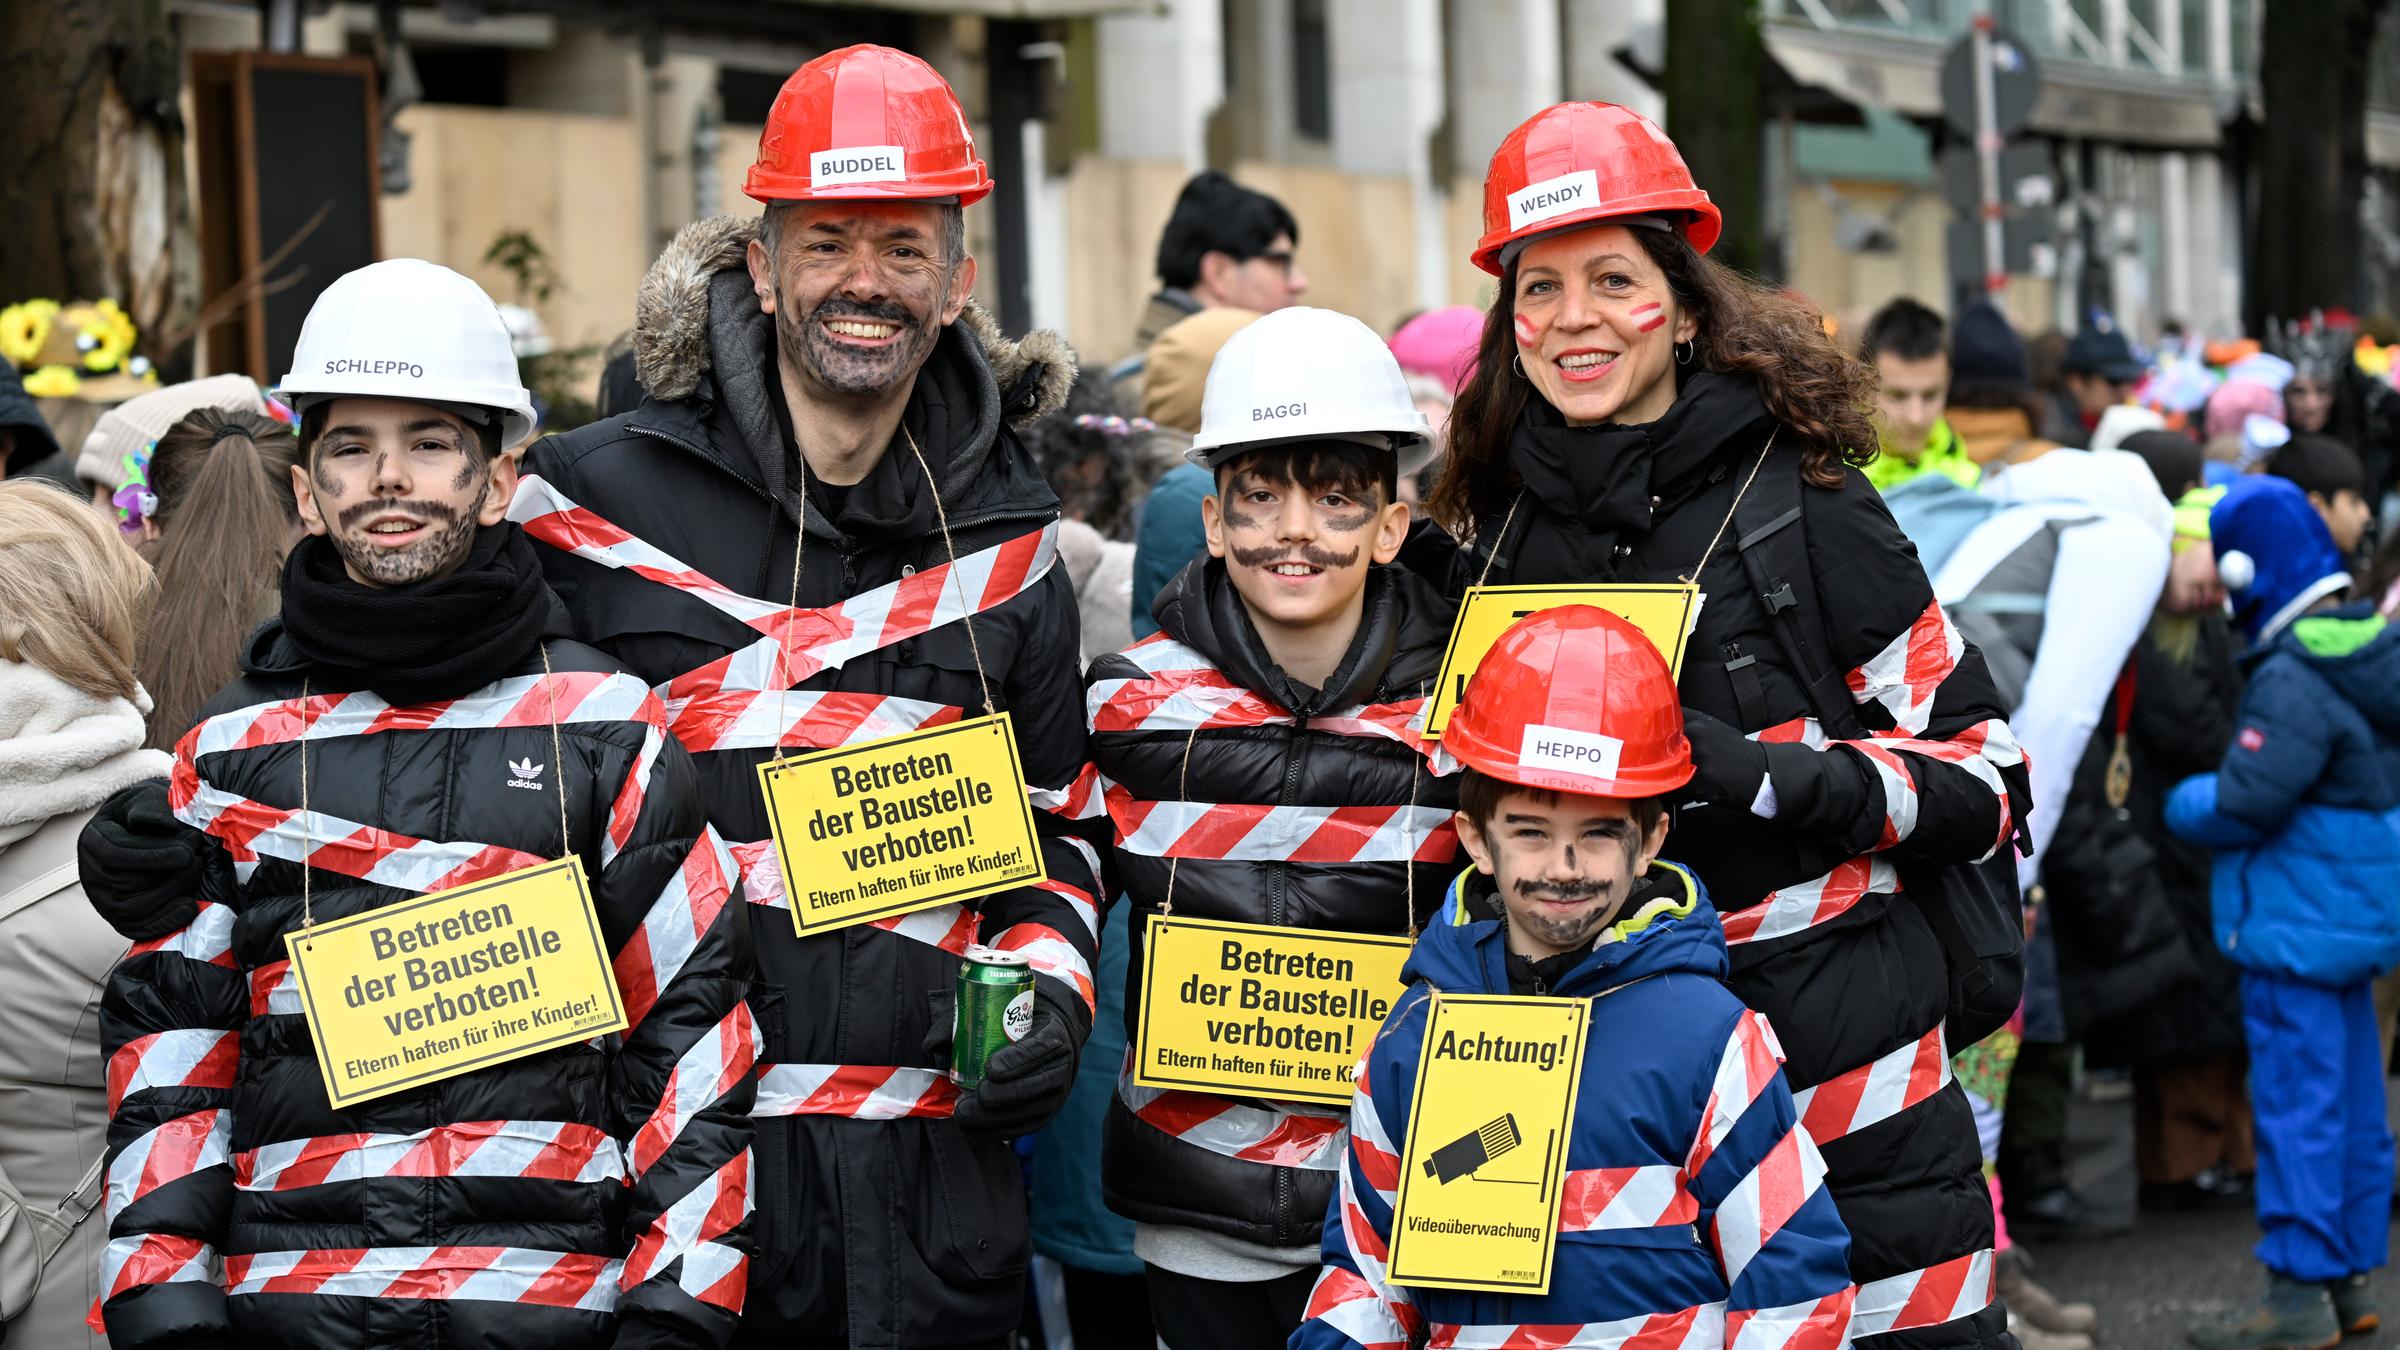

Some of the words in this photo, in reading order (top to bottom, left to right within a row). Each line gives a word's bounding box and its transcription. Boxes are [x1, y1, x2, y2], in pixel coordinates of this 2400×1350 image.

[821, 157, 896, 176] BUDDEL
[1520, 184, 1582, 214] WENDY
[325, 359, 423, 378] SCHLEPPO
[1252, 402, 1307, 421] BAGGI
[1536, 740, 1601, 763] HEPPO
[507, 779, 543, 791] adidas
[831, 753, 953, 797] Betreten
[808, 809, 854, 841] der
[860, 777, 992, 829] Baustelle
[842, 815, 974, 871] verboten!
[809, 888, 855, 909] Eltern
[858, 877, 907, 898] haften
[910, 869, 930, 887] für
[934, 864, 964, 881] ihre
[967, 847, 1022, 874] Kinder!
[370, 904, 513, 960] Betreten
[344, 974, 397, 1008] der
[404, 927, 562, 991] Baustelle
[1221, 940, 1353, 982] Betreten
[384, 967, 539, 1035] verboten!
[1181, 974, 1231, 1006] der
[1240, 979, 1388, 1021] Baustelle
[346, 1055, 399, 1079] Eltern
[403, 1038, 460, 1063] haften
[463, 1027, 487, 1046] für
[492, 1019, 528, 1038] ihre
[532, 995, 597, 1027] Kinder!
[1207, 1017, 1353, 1054] verboten!
[1434, 1030, 1568, 1071] Achtung!
[1158, 1048, 1206, 1069] Eltern
[1212, 1054, 1264, 1074] haften
[1270, 1059, 1293, 1077] für
[1298, 1062, 1331, 1080] ihre
[1409, 1216, 1540, 1242] Videoüberwachung
